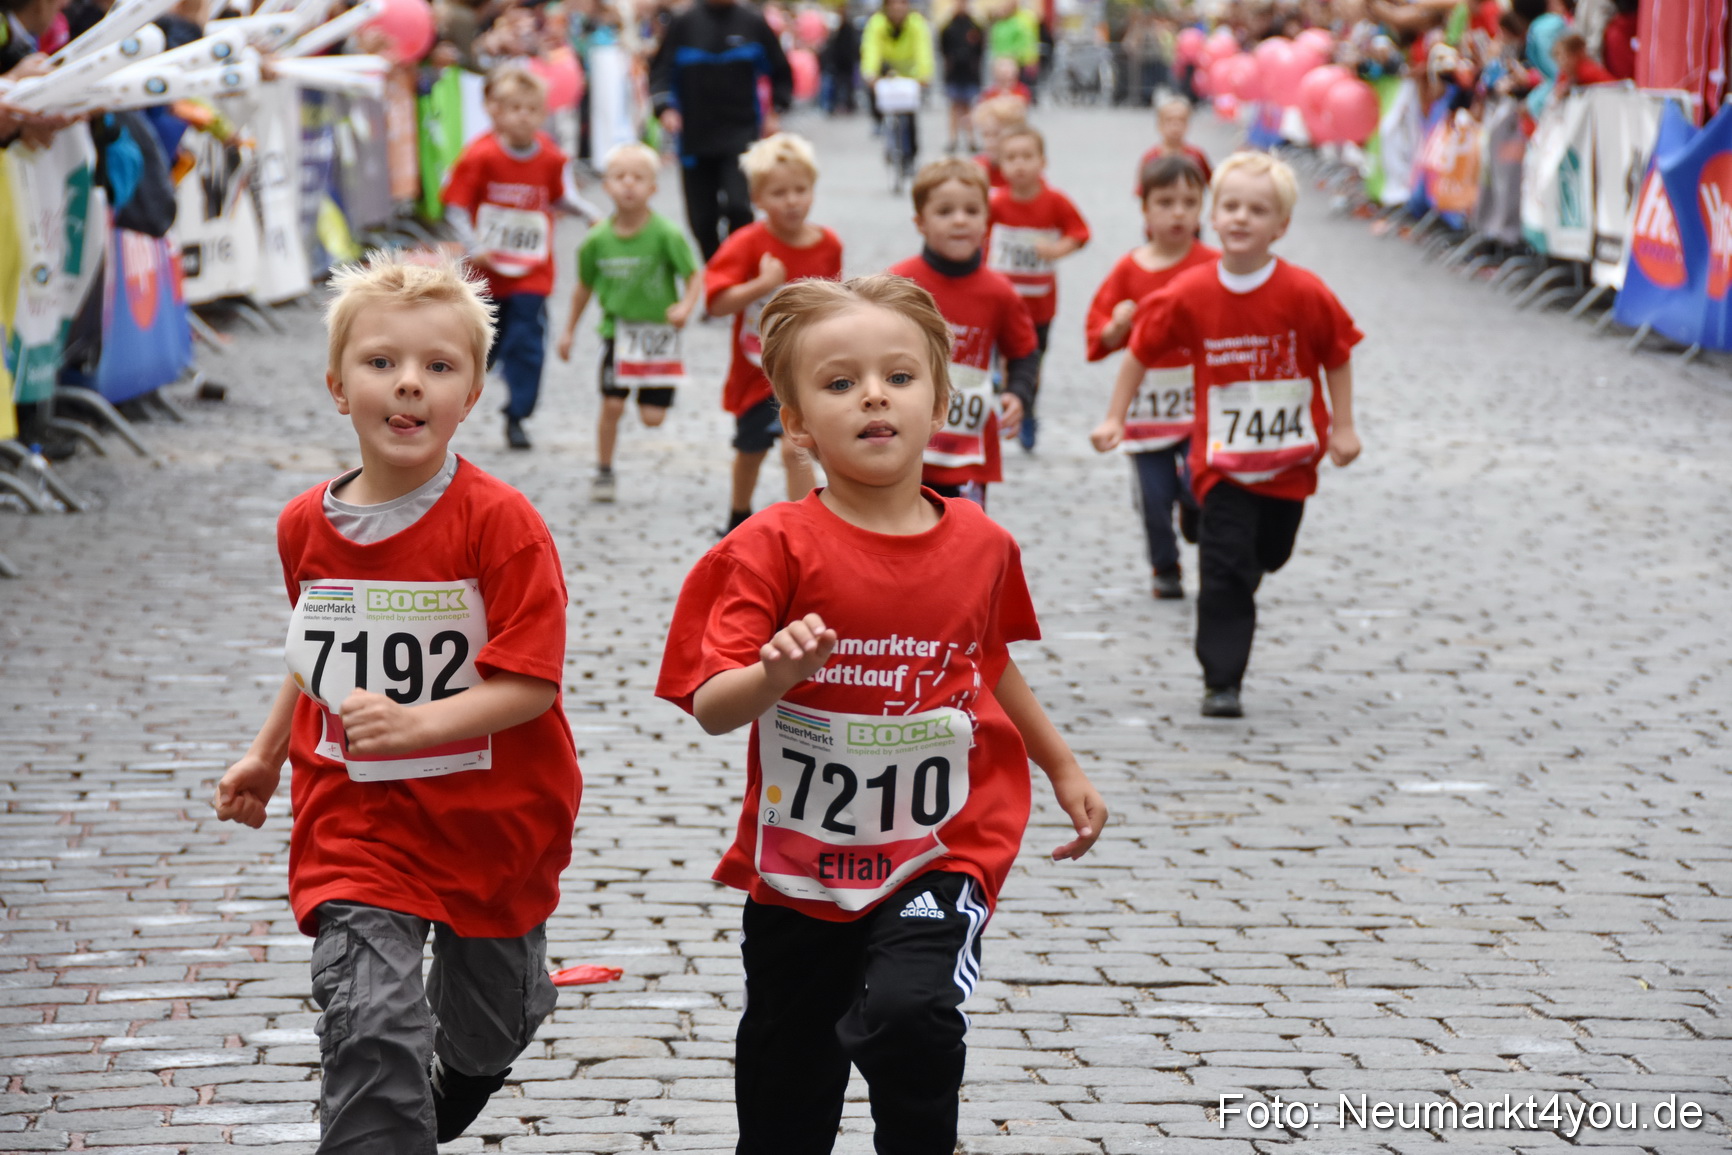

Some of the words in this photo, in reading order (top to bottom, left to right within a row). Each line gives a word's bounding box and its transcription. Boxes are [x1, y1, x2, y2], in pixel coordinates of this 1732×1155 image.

[947, 393, 983, 429] 89
[1222, 405, 1303, 444] 7444
[303, 602, 356, 614] NeuerMarkt
[367, 588, 469, 613] BOCK
[366, 612, 395, 621] inspired
[397, 613, 405, 622] by
[434, 611, 470, 620] concepts
[831, 634, 940, 657] markter
[304, 630, 470, 704] 7192
[806, 664, 909, 692] adtlauf
[775, 719, 834, 746] NeuerMarkt
[847, 715, 955, 747] BOCK
[846, 746, 881, 756] inspired
[883, 747, 893, 756] by
[895, 744, 919, 754] smart
[782, 747, 950, 836] 7210
[768, 810, 775, 823] 2
[818, 852, 893, 881] Eliah
[900, 906, 945, 920] adidas
